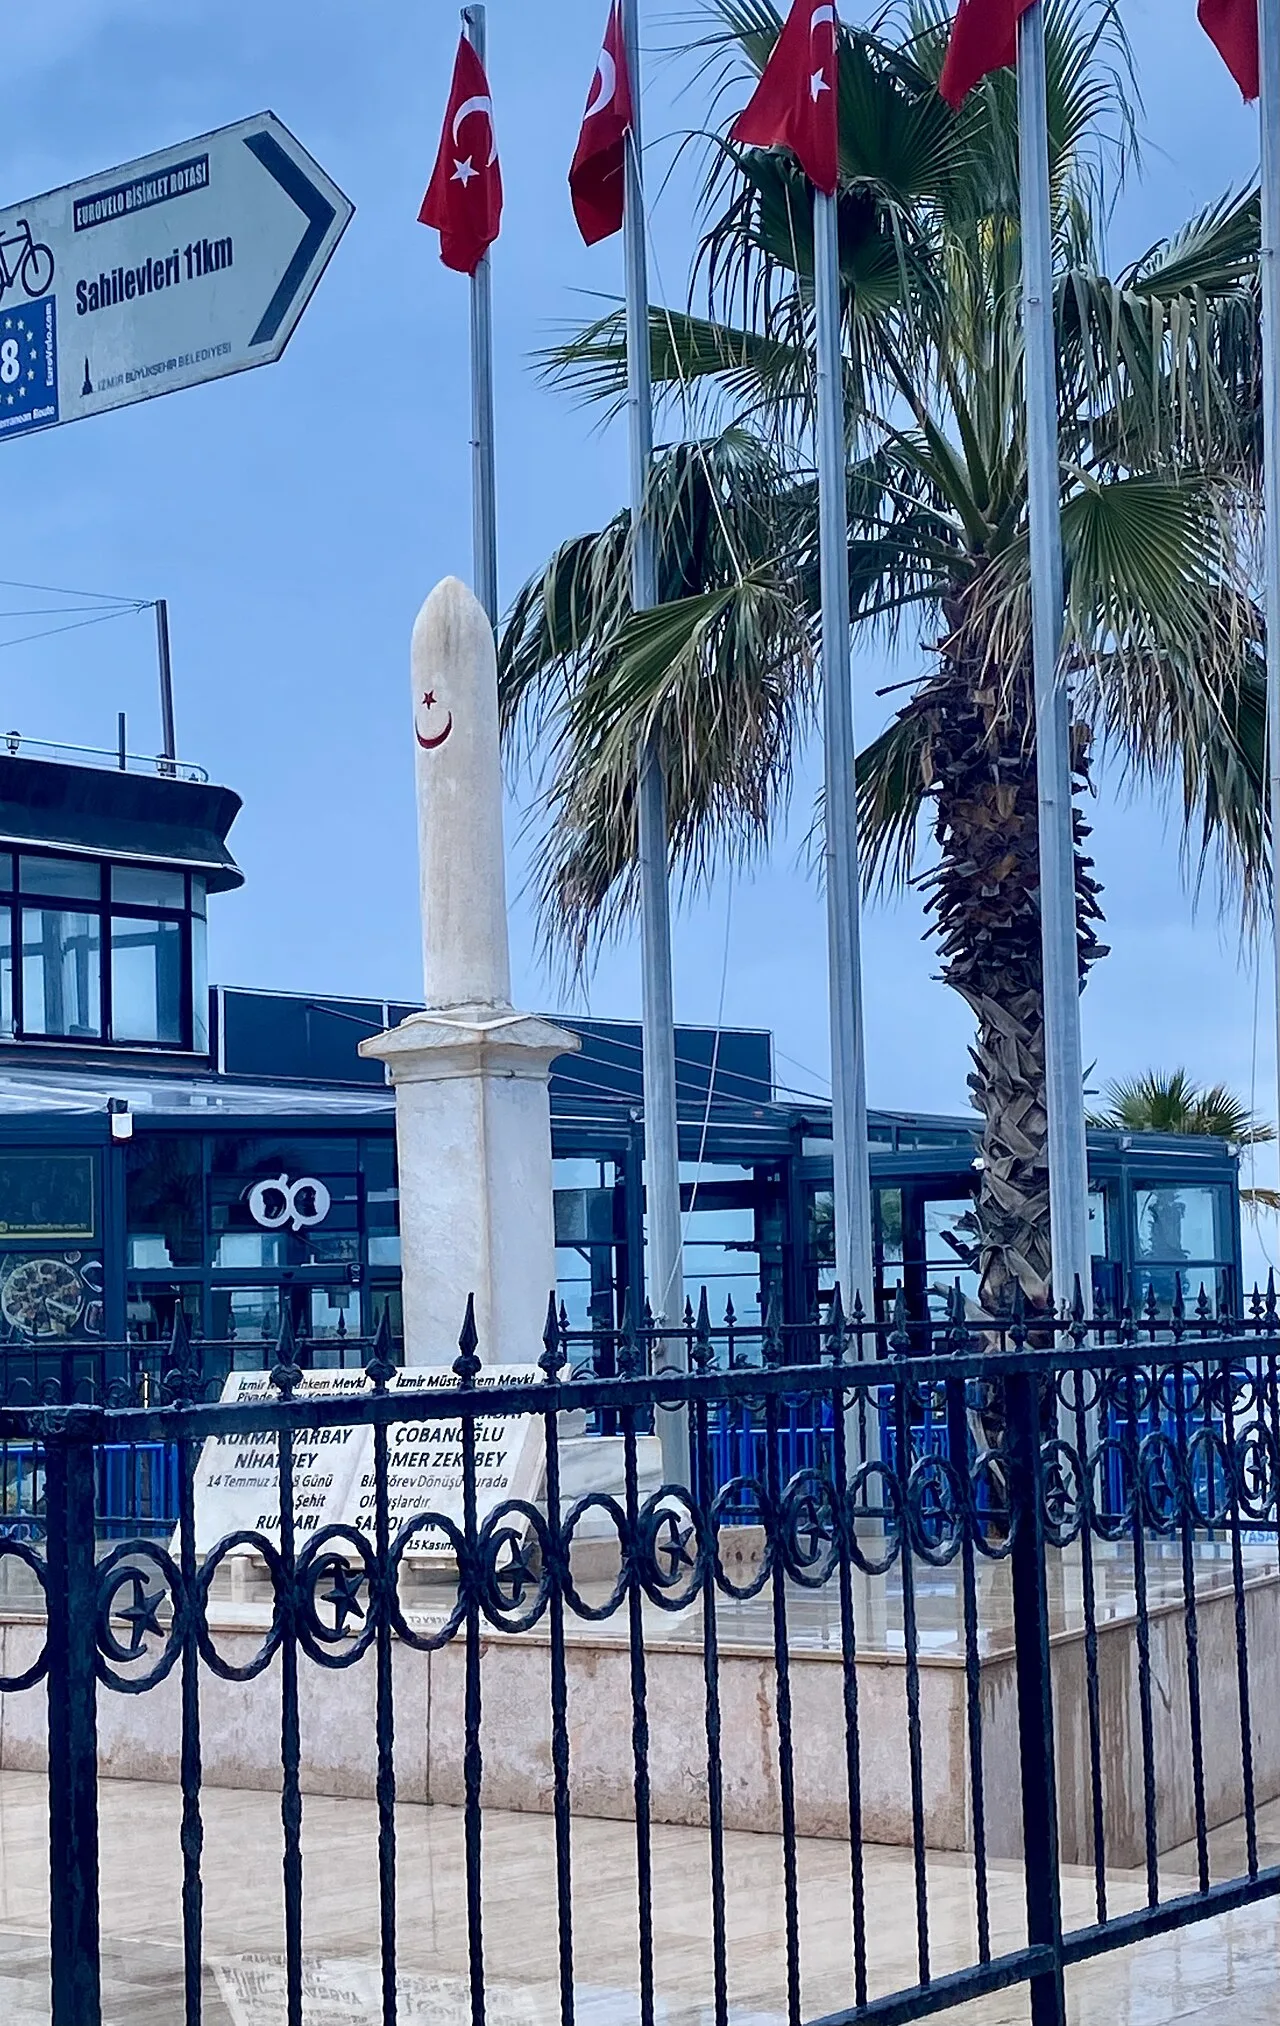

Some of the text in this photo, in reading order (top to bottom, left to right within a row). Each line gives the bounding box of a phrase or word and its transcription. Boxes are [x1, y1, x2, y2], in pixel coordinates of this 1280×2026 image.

[77, 162, 206, 226] EUROVELO BİSİKLET ROTASI
[75, 237, 233, 315] Sahilevleri 11km
[0, 339, 20, 384] 8
[396, 1372, 426, 1388] İzmir
[217, 1430, 286, 1445] KURMA
[207, 1474, 222, 1488] 14
[223, 1474, 270, 1488] Temmuz
[301, 1473, 334, 1488] Günü
[294, 1494, 327, 1511] Şehit
[407, 1539, 420, 1550] 15
